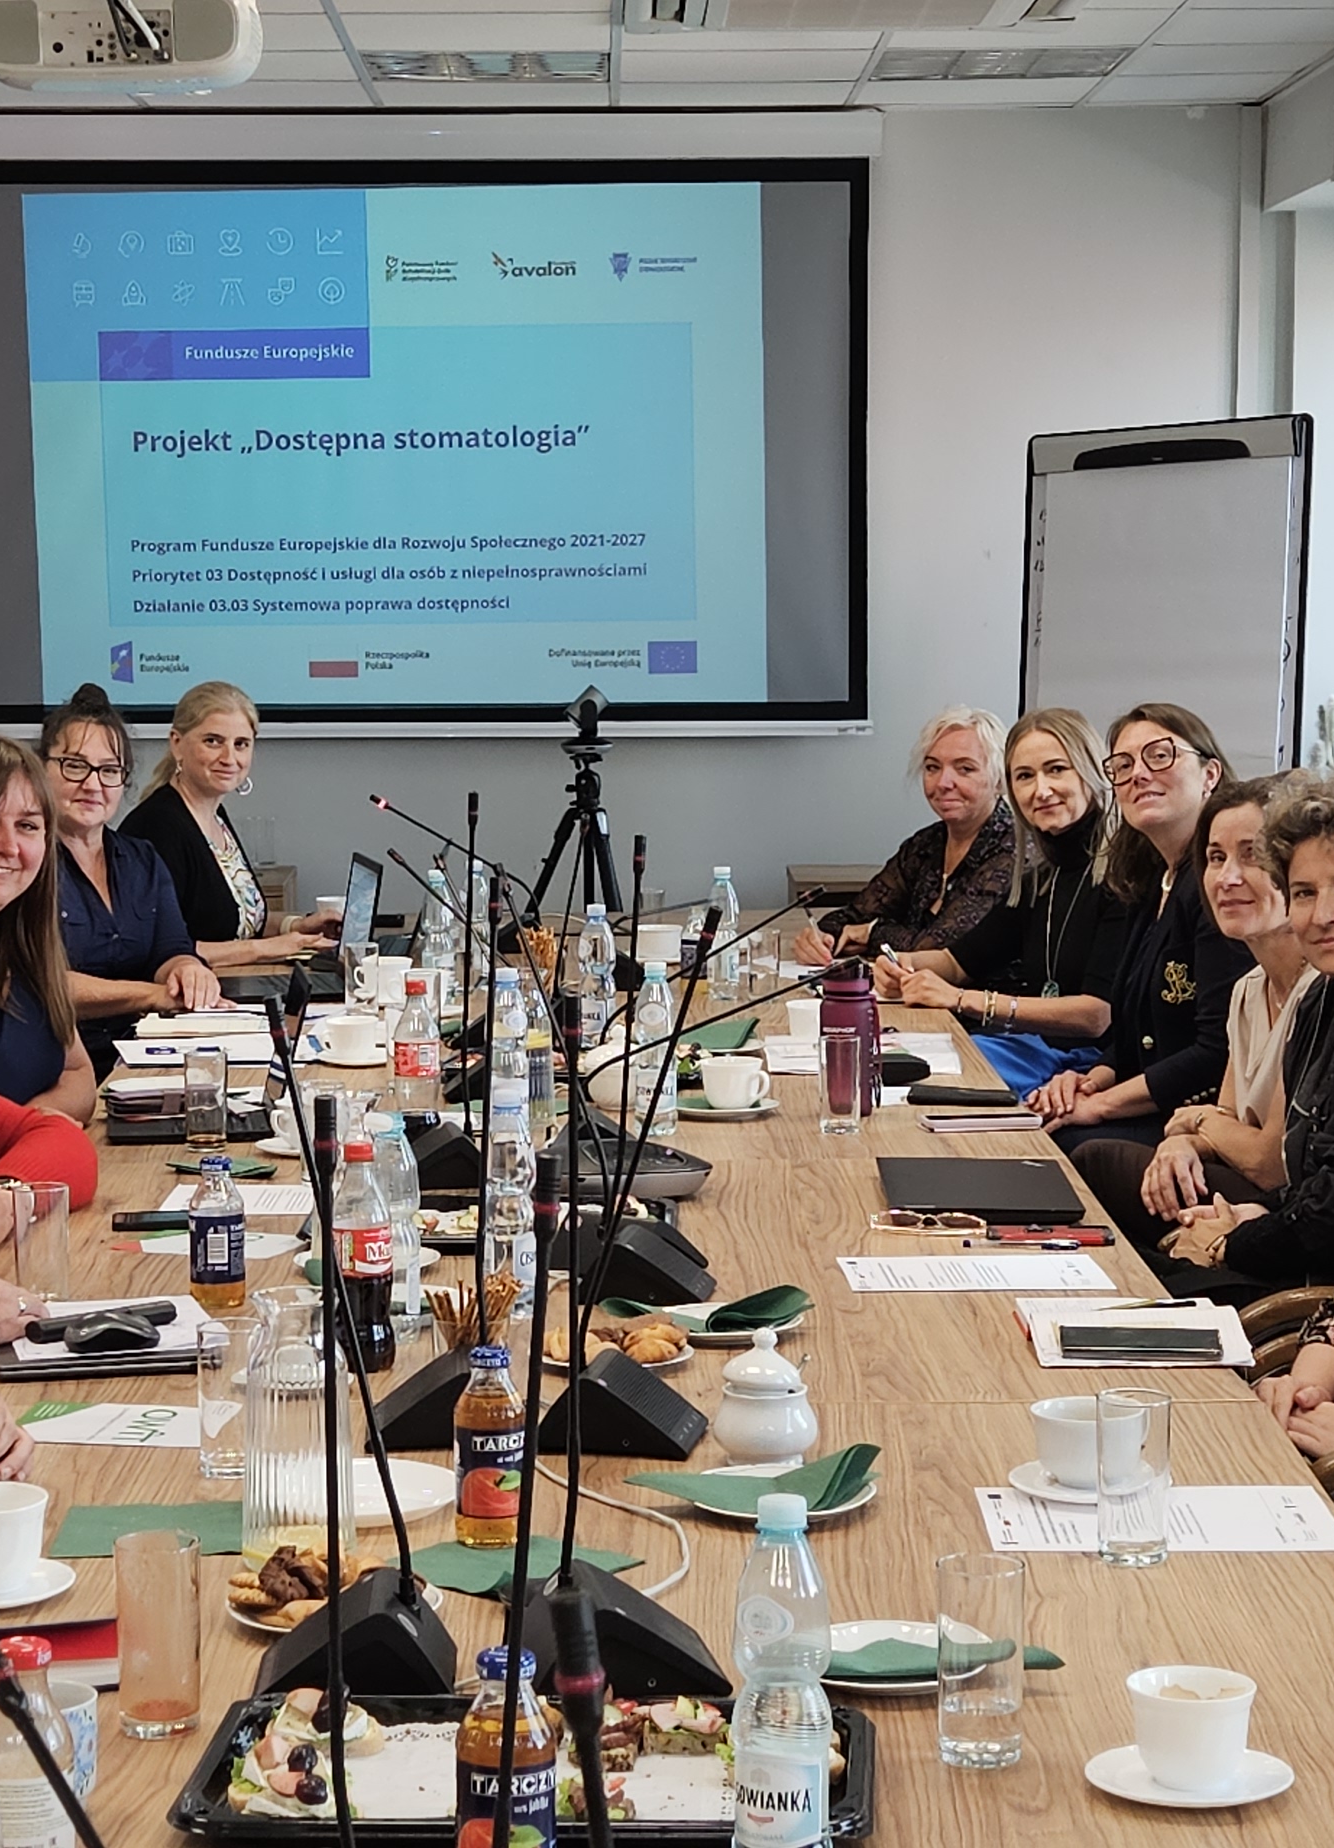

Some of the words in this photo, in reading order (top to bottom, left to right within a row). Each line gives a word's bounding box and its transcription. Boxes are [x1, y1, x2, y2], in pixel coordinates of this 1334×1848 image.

[511, 261, 577, 277] avalon
[185, 346, 259, 360] Fundusze
[263, 343, 355, 362] Europejskie
[132, 429, 232, 458] Projekt
[240, 429, 386, 457] „Dostępna
[393, 424, 590, 454] stomatologia”
[130, 538, 197, 556] Program
[201, 538, 275, 553] Fundusze
[279, 536, 369, 554] Europejskie
[372, 536, 397, 551] dla
[401, 535, 467, 553] Rozwoju
[470, 534, 566, 552] Społecznego
[569, 533, 647, 549] 2021-2027
[132, 568, 202, 586] Priorytet
[205, 568, 224, 582] 03
[227, 566, 318, 585] Dostępność
[330, 566, 377, 583] usługi
[380, 566, 405, 580] dla
[409, 565, 446, 580] osób
[450, 567, 459, 580] z
[461, 562, 648, 582] niepełnosprawnościami
[133, 599, 206, 613] Działanie
[208, 599, 249, 613] 03.03
[252, 598, 341, 616] Systemowa
[345, 600, 413, 615] poprawa
[416, 595, 510, 613] dostępności
